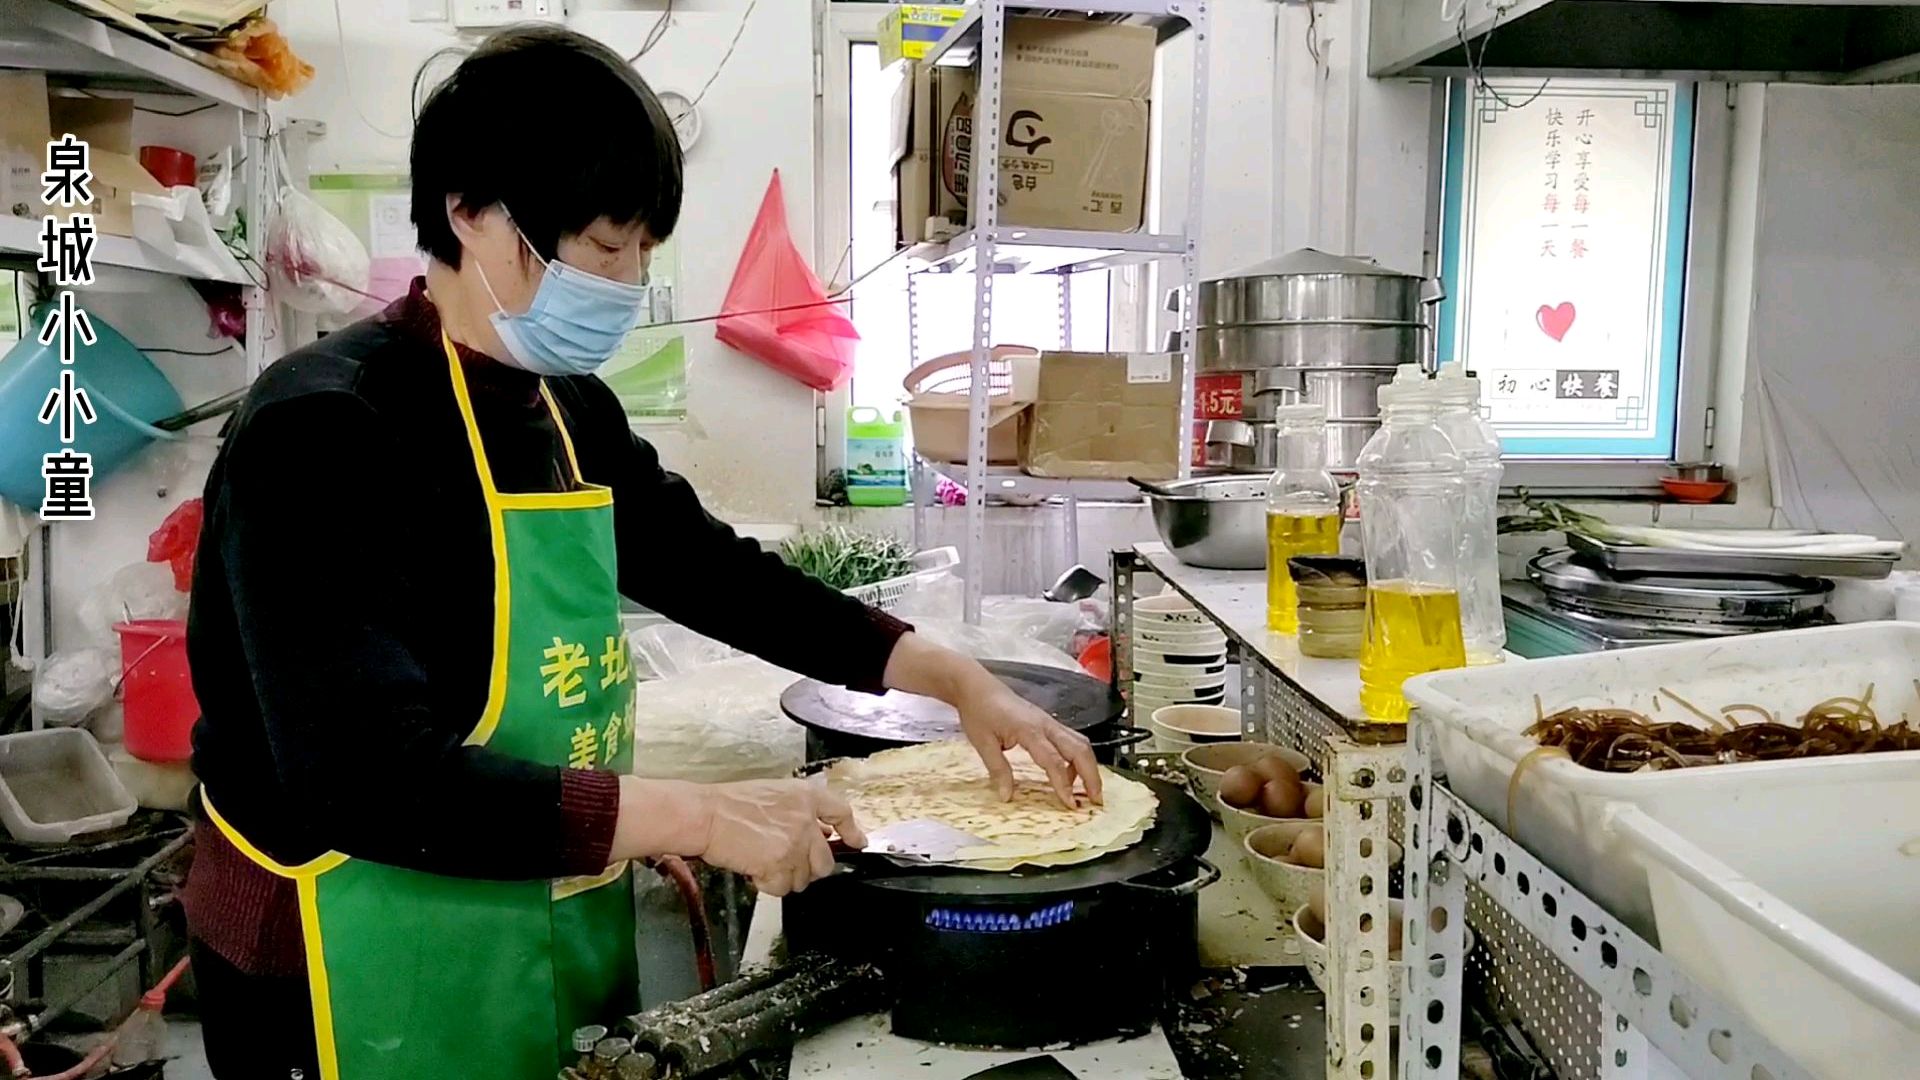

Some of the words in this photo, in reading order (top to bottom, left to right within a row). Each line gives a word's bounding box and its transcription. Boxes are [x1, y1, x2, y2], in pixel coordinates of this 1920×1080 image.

[1540, 106, 1564, 258] 快乐学习每一天
[1569, 108, 1595, 260] 开心享受每一餐
[1498, 371, 1619, 399] 初心快餐
